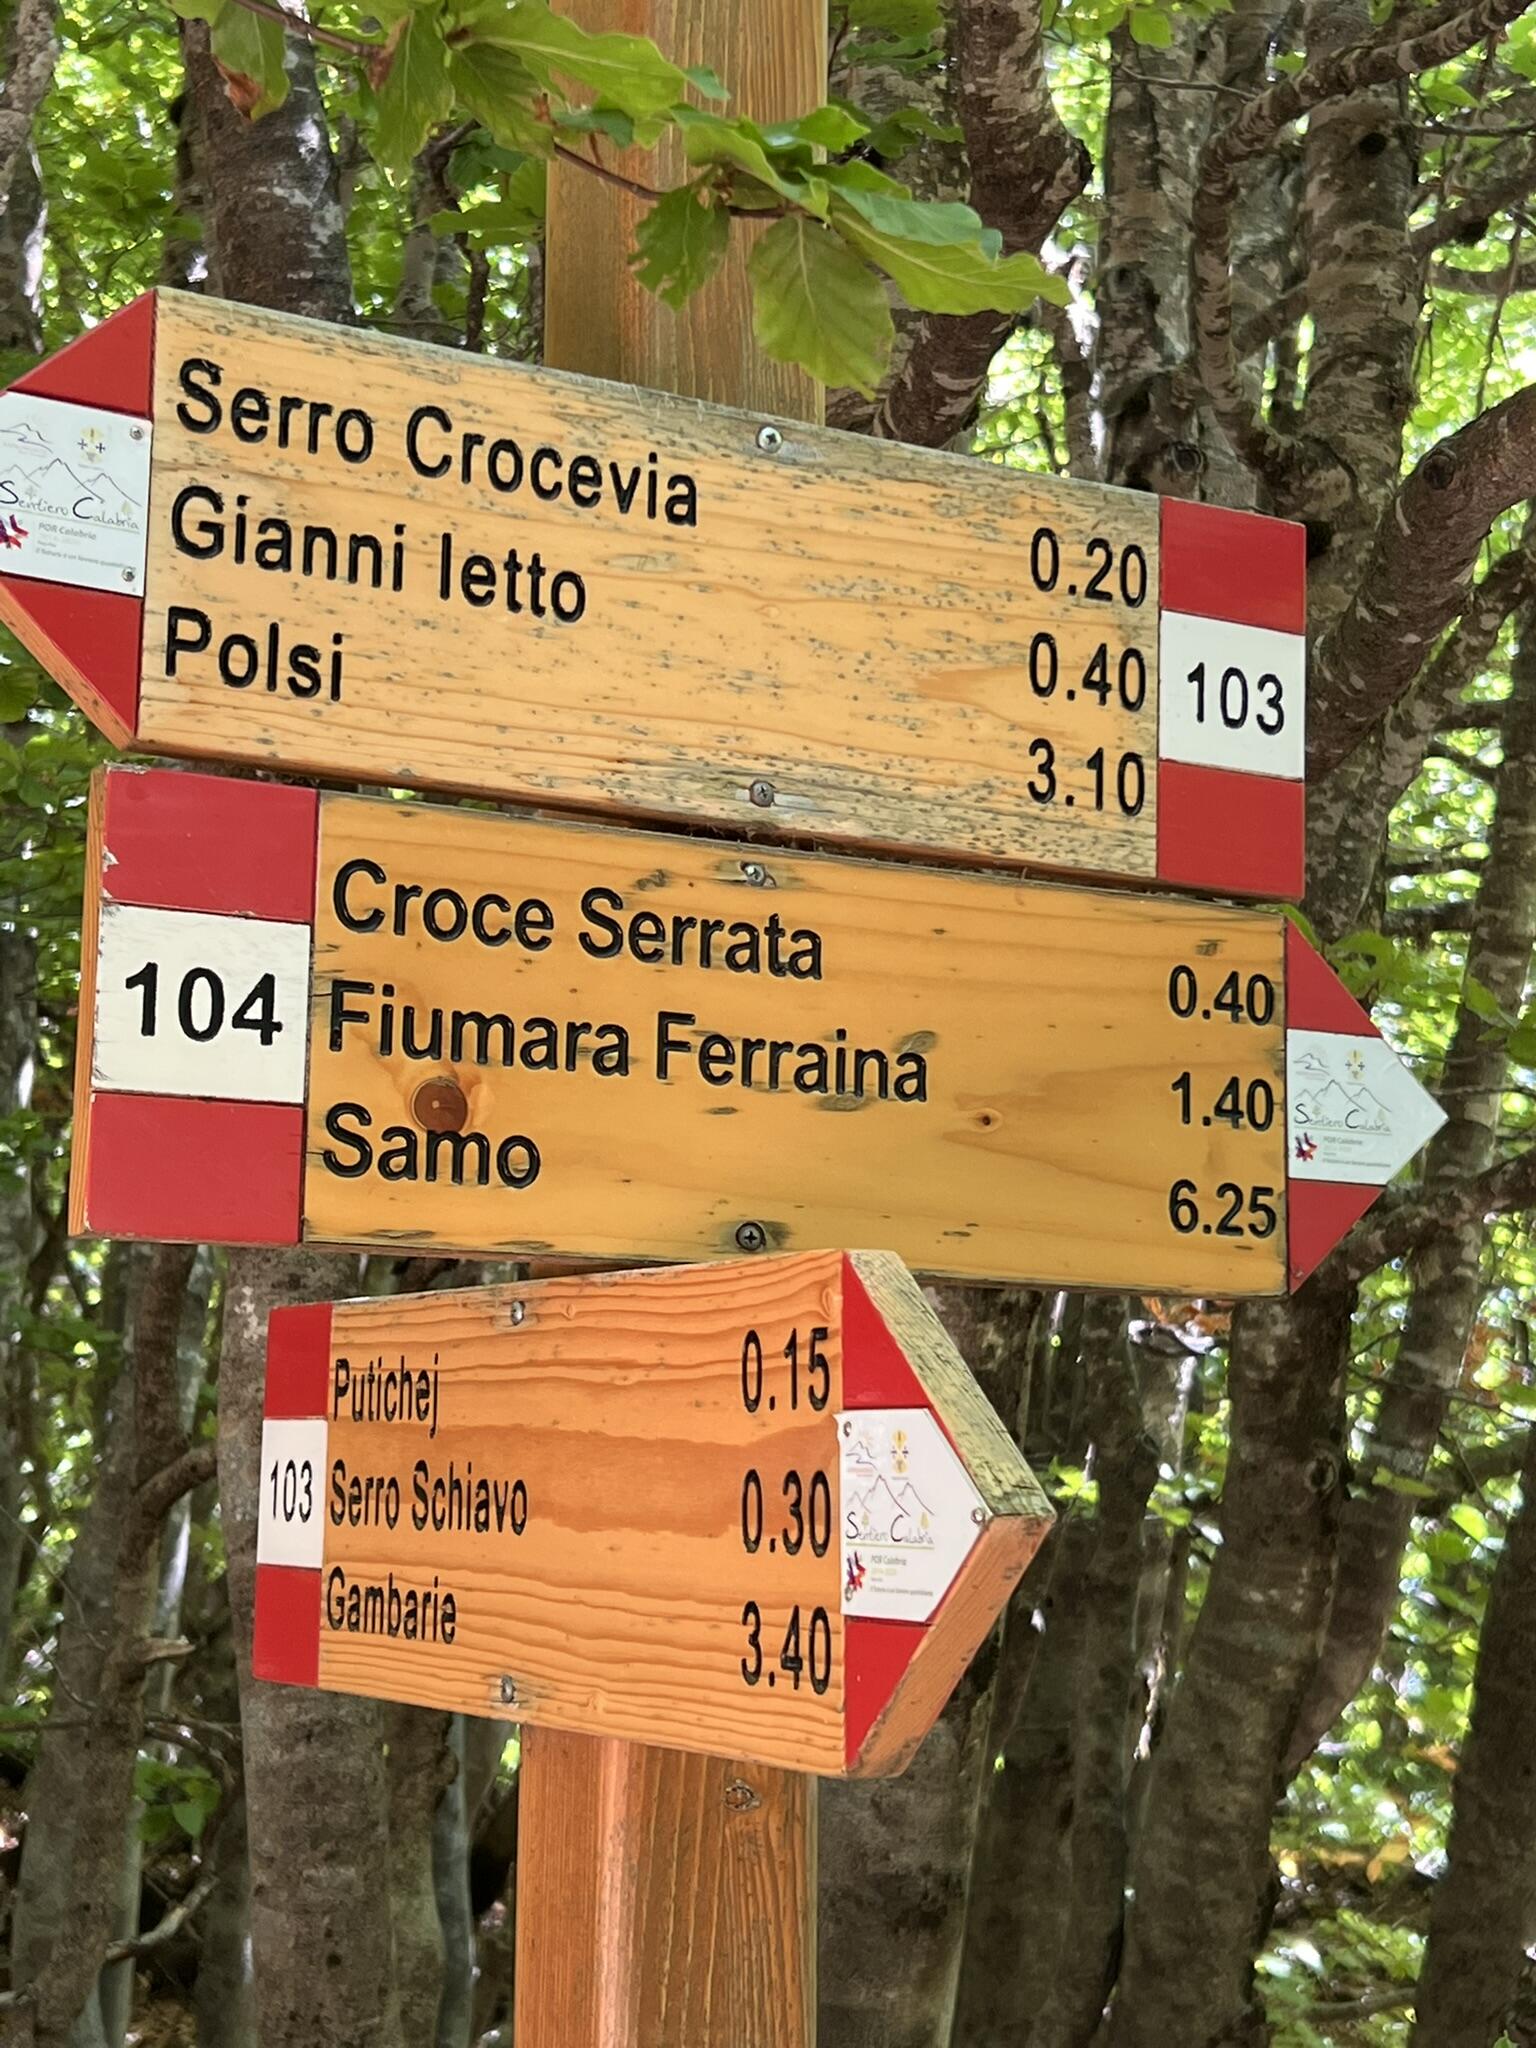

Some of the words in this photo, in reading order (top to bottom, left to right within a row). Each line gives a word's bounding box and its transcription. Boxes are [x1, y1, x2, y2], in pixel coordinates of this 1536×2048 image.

[175, 357, 374, 463] Serro
[406, 405, 698, 527] Crocevia
[1030, 527, 1148, 609] 0.20
[171, 485, 407, 592] Gianni
[1028, 632, 1146, 712] 0.40
[165, 605, 343, 702] Polsi
[1027, 738, 1146, 817] 3.10
[1187, 662, 1286, 736] 103
[124, 961, 284, 1047] 104
[332, 858, 555, 952] Croce
[577, 886, 824, 981] Serrata
[1168, 964, 1275, 1026] 0.40
[329, 980, 631, 1077] Fiumara
[655, 1010, 929, 1104] Ferraina
[1171, 1071, 1275, 1132] 1.40
[322, 1102, 542, 1190] Samo
[1168, 1178, 1277, 1239] 6.25
[333, 1352, 439, 1439] Putichej
[741, 1327, 831, 1413] 0.15
[270, 1459, 313, 1523] 103
[329, 1458, 400, 1531] Serro
[411, 1459, 528, 1537] Schiavo
[741, 1468, 832, 1558] 0.30
[326, 1565, 457, 1645] Gambarie
[740, 1600, 832, 1696] 3.40
